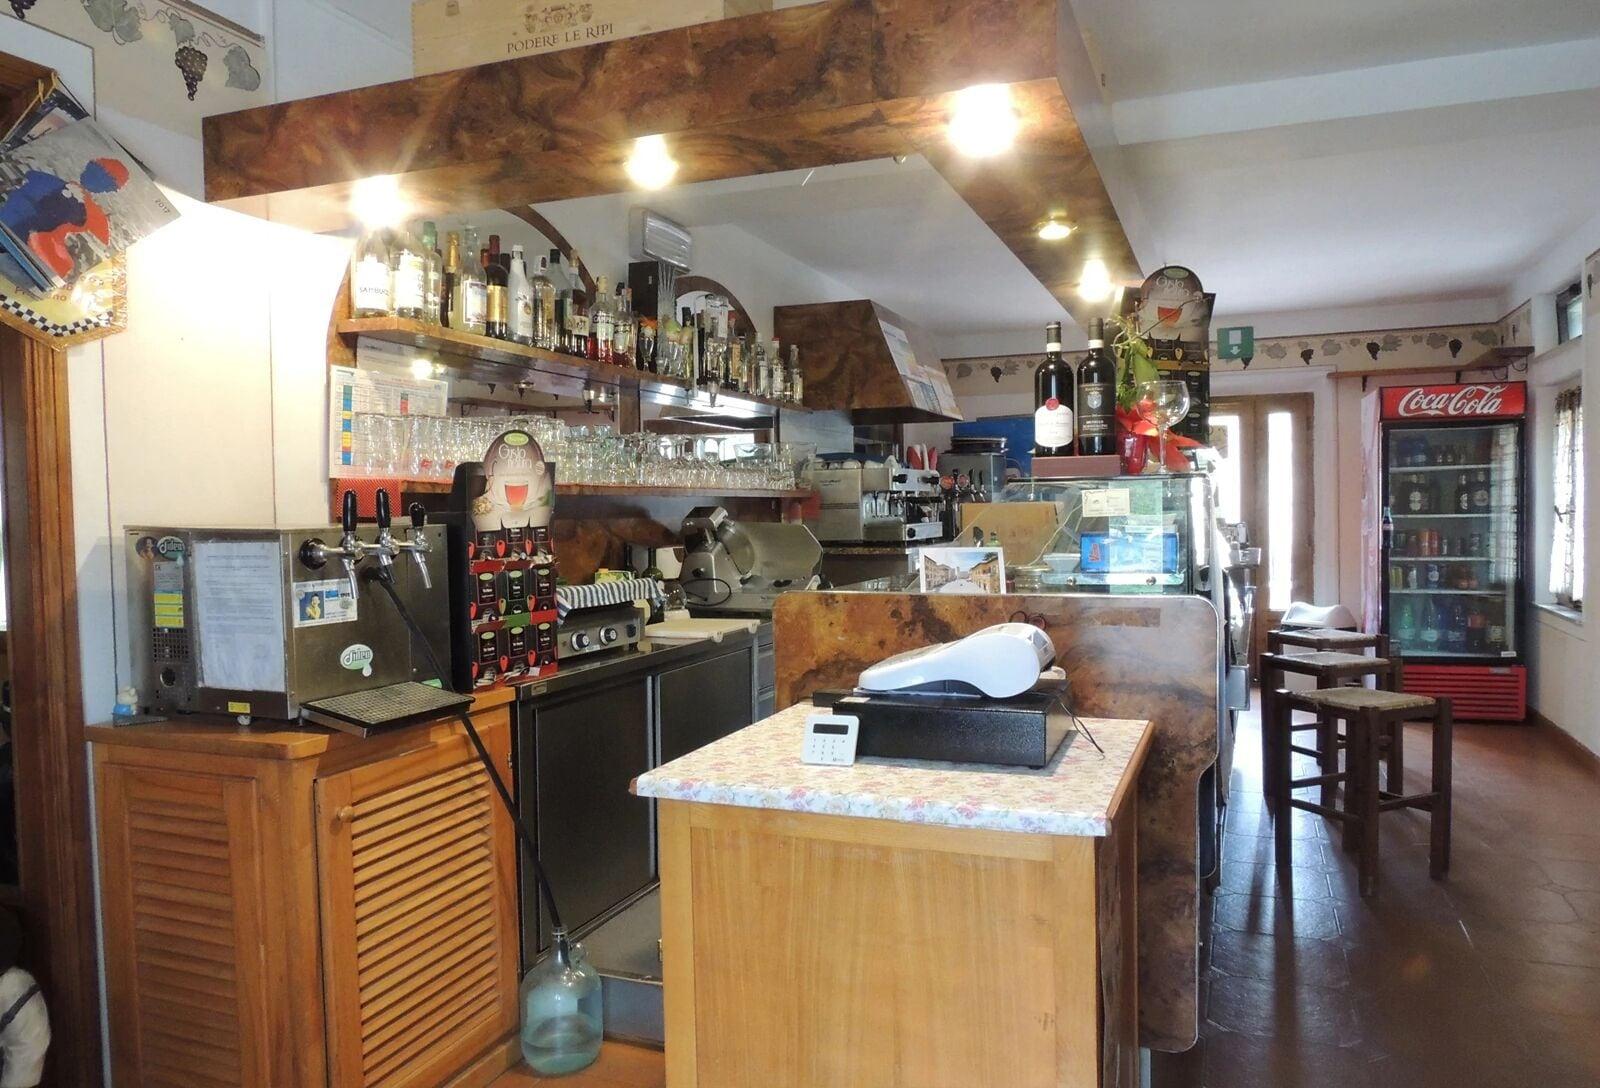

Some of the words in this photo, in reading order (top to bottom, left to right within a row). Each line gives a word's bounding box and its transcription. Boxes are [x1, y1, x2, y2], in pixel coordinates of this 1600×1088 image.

[507, 33, 559, 54] PODERE
[565, 29, 581, 43] LE
[586, 23, 614, 39] RIPI
[1398, 384, 1510, 417] Coca-Cola
